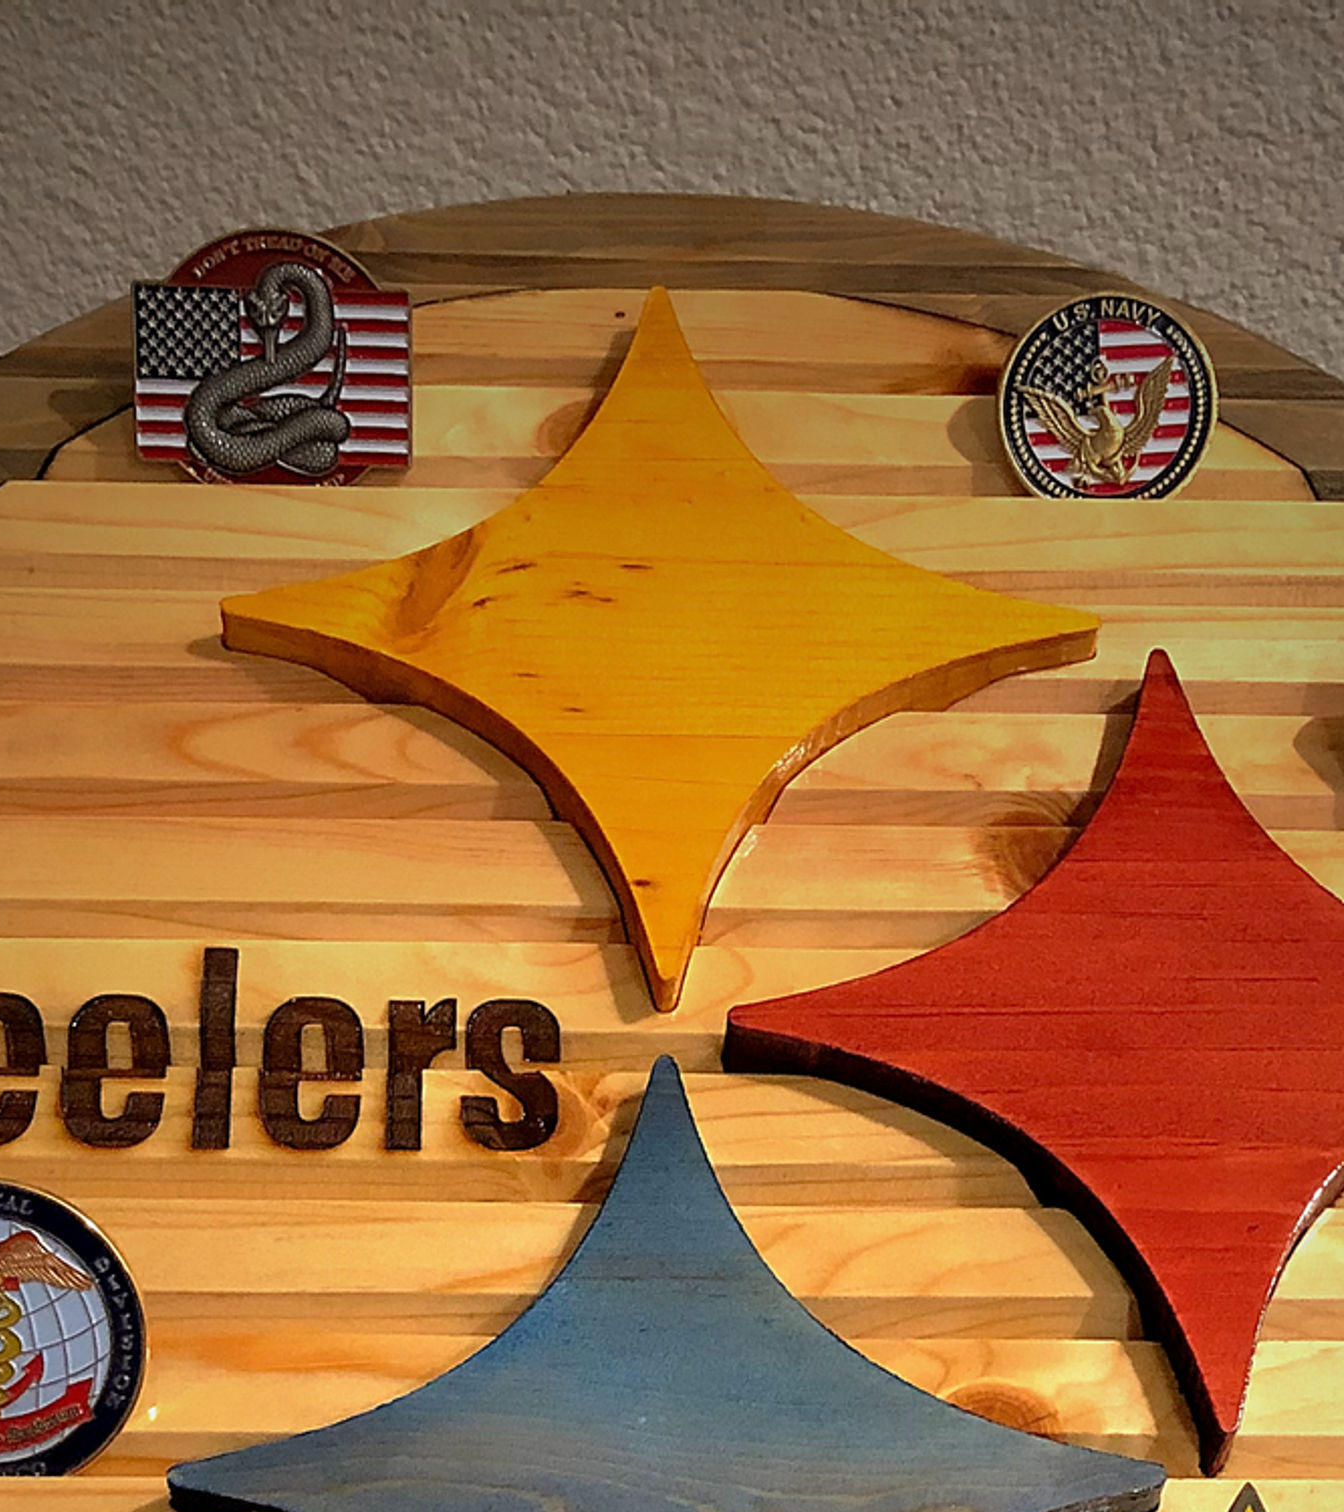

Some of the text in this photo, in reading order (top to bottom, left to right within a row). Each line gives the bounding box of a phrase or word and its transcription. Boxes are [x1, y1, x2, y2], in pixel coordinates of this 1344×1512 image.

[1052, 298, 1161, 331] U.S. NAVY
[94, 1256, 135, 1409] DIVISION
